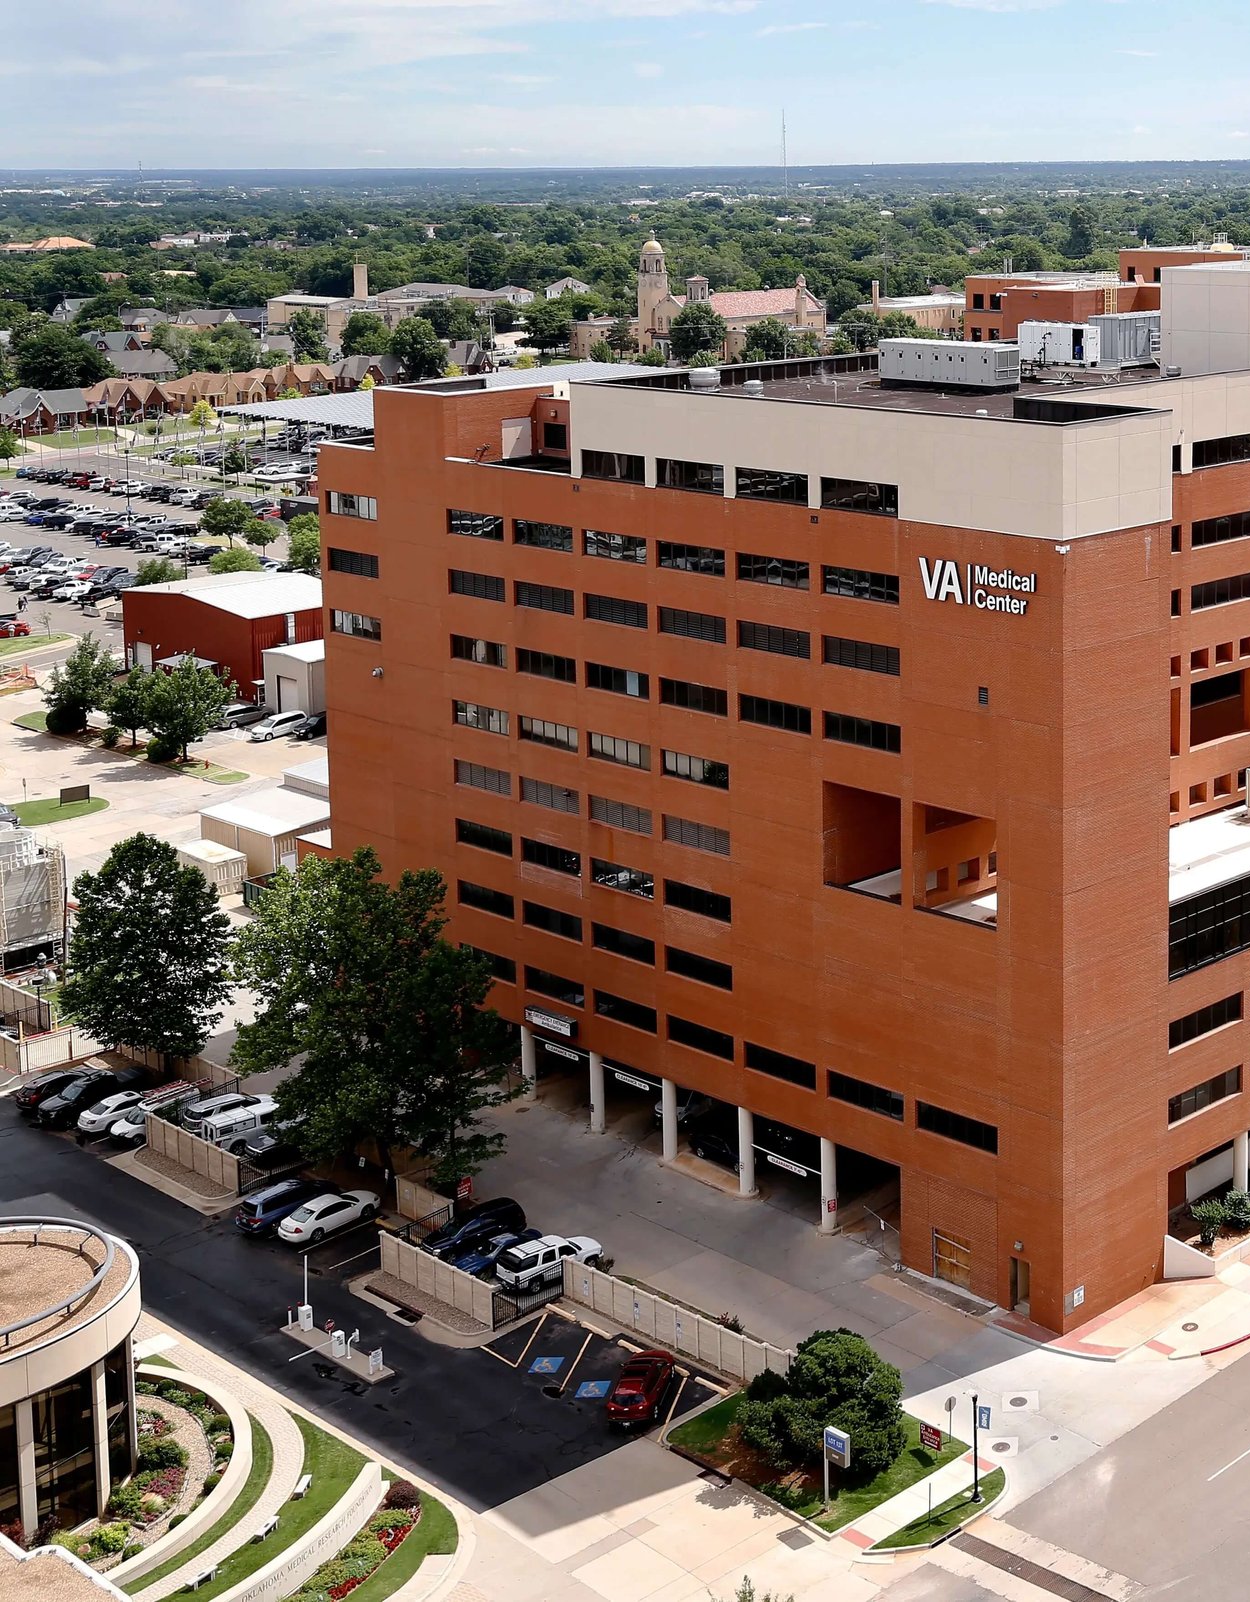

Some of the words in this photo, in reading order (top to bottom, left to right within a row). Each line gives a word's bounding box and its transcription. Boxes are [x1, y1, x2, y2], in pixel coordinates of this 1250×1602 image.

[918, 556, 963, 604] VA
[975, 565, 1035, 593] Medical
[974, 589, 1027, 615] Center
[241, 1571, 285, 1602] OKLAHOMA
[287, 1546, 315, 1573] MEDICAL
[317, 1516, 346, 1548] RESEARCH
